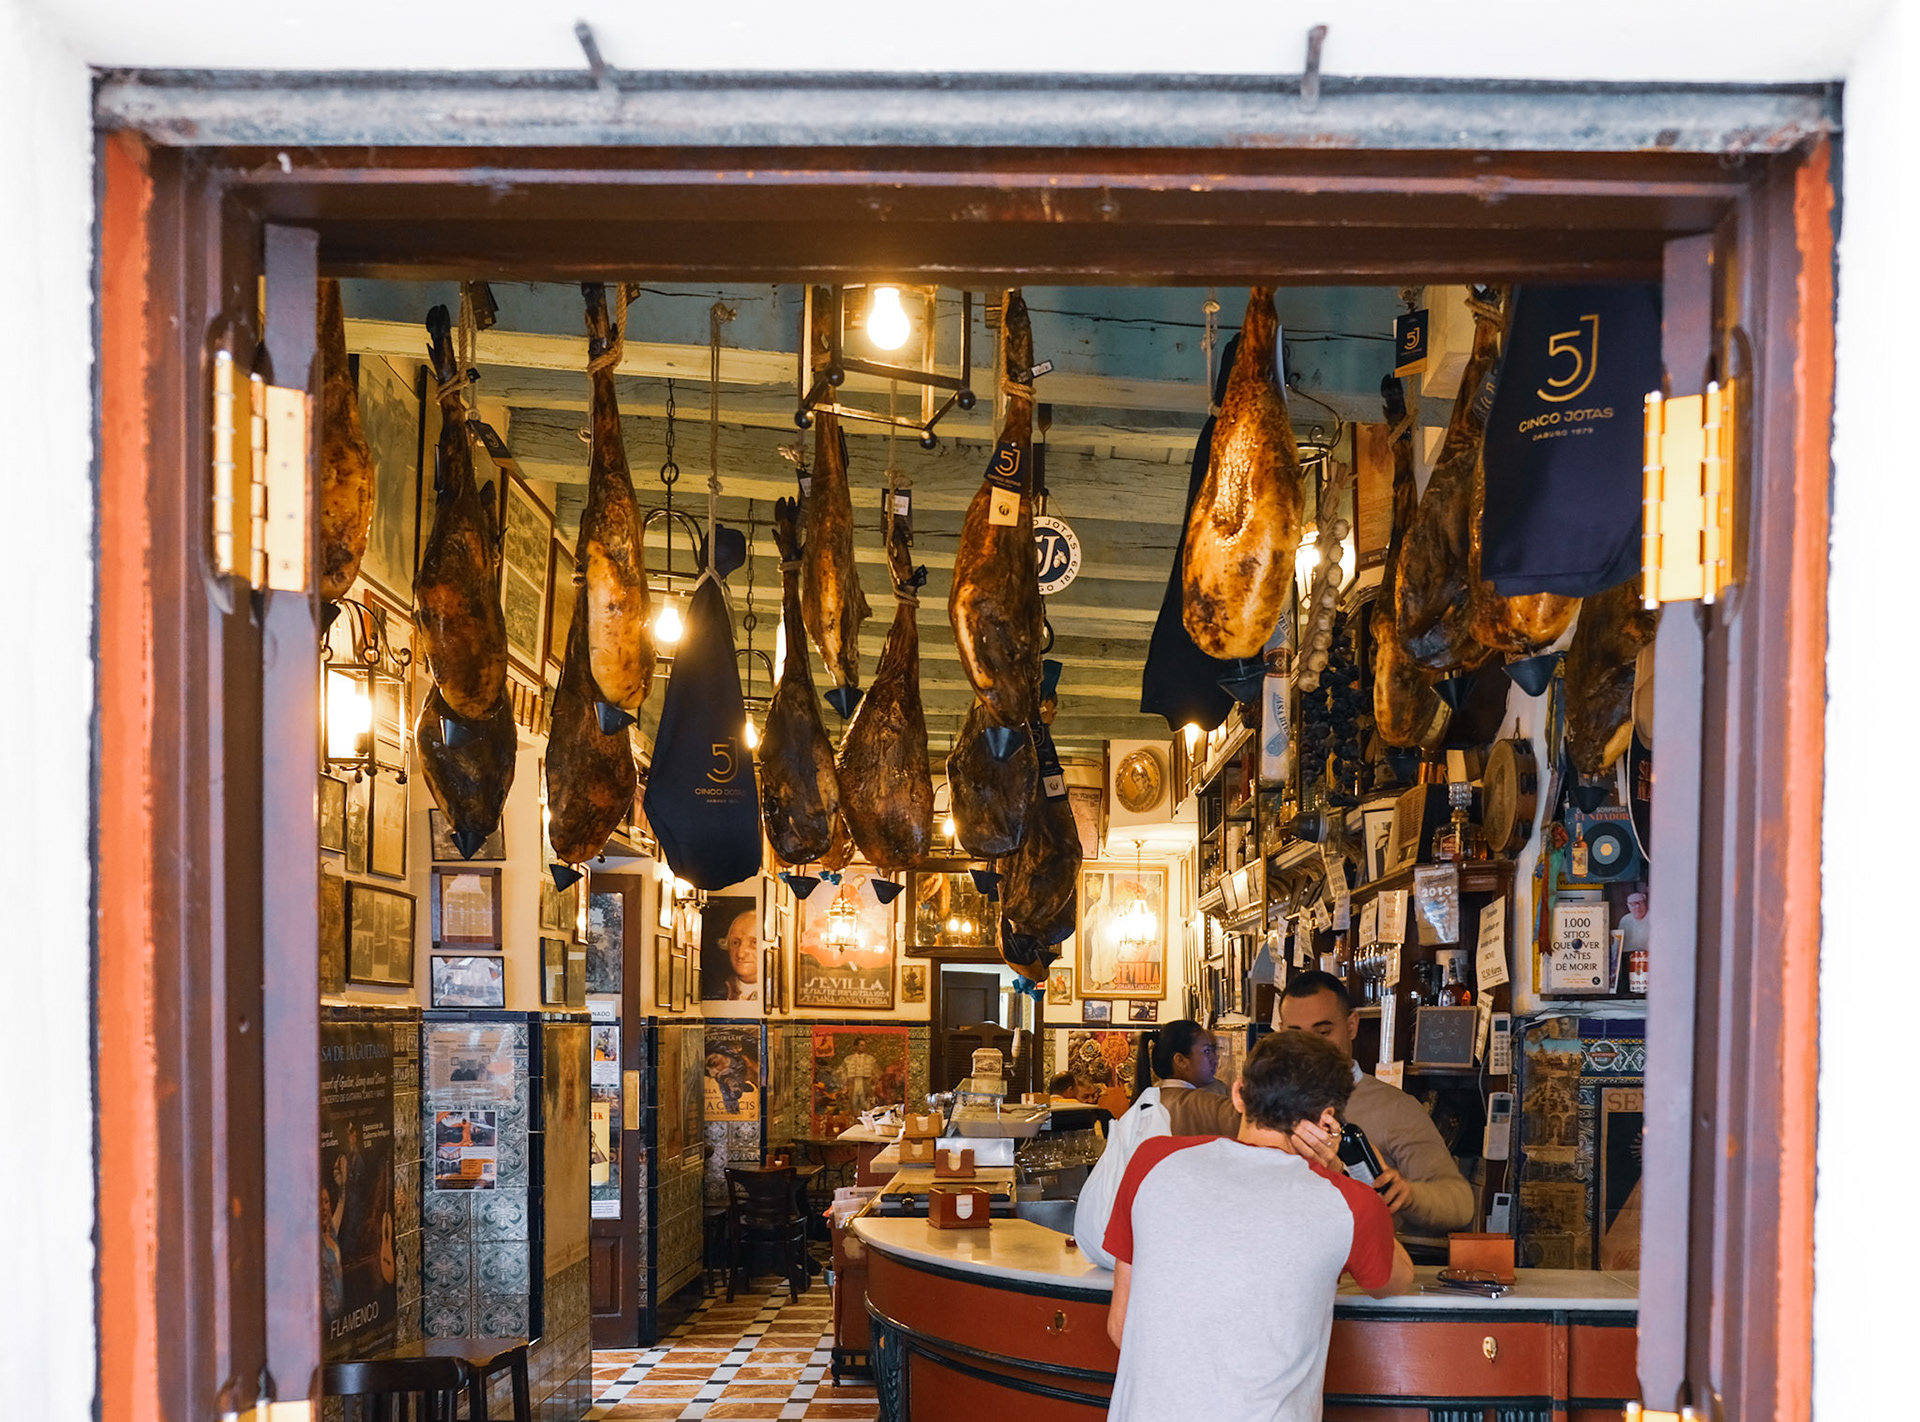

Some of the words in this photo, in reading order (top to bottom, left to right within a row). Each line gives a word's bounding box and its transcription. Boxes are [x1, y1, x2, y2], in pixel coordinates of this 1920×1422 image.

[1536, 313, 1600, 402] 5J
[1518, 412, 1561, 433] CINCO
[1563, 407, 1614, 422] JOTAS
[994, 448, 1020, 476] 5J
[1045, 519, 1078, 550] JOTAS
[1060, 560, 1079, 586] 1879
[695, 788, 722, 796] CINCO
[1421, 886, 1452, 897] 2013
[1564, 918, 1591, 928] 1.000
[1563, 930, 1590, 938] SITIOS
[1553, 941, 1572, 950] QUE
[1582, 941, 1600, 949] VER
[1563, 951, 1591, 959] ANTES
[1112, 962, 1160, 984] SEVILLA
[1569, 963, 1598, 971] MORIR
[805, 977, 885, 990] SEVILLA
[321, 1045, 333, 1062] SA
[333, 1045, 345, 1061] DE
[717, 1101, 755, 1110] CCIS
[330, 1301, 379, 1340] FLAMENCO
